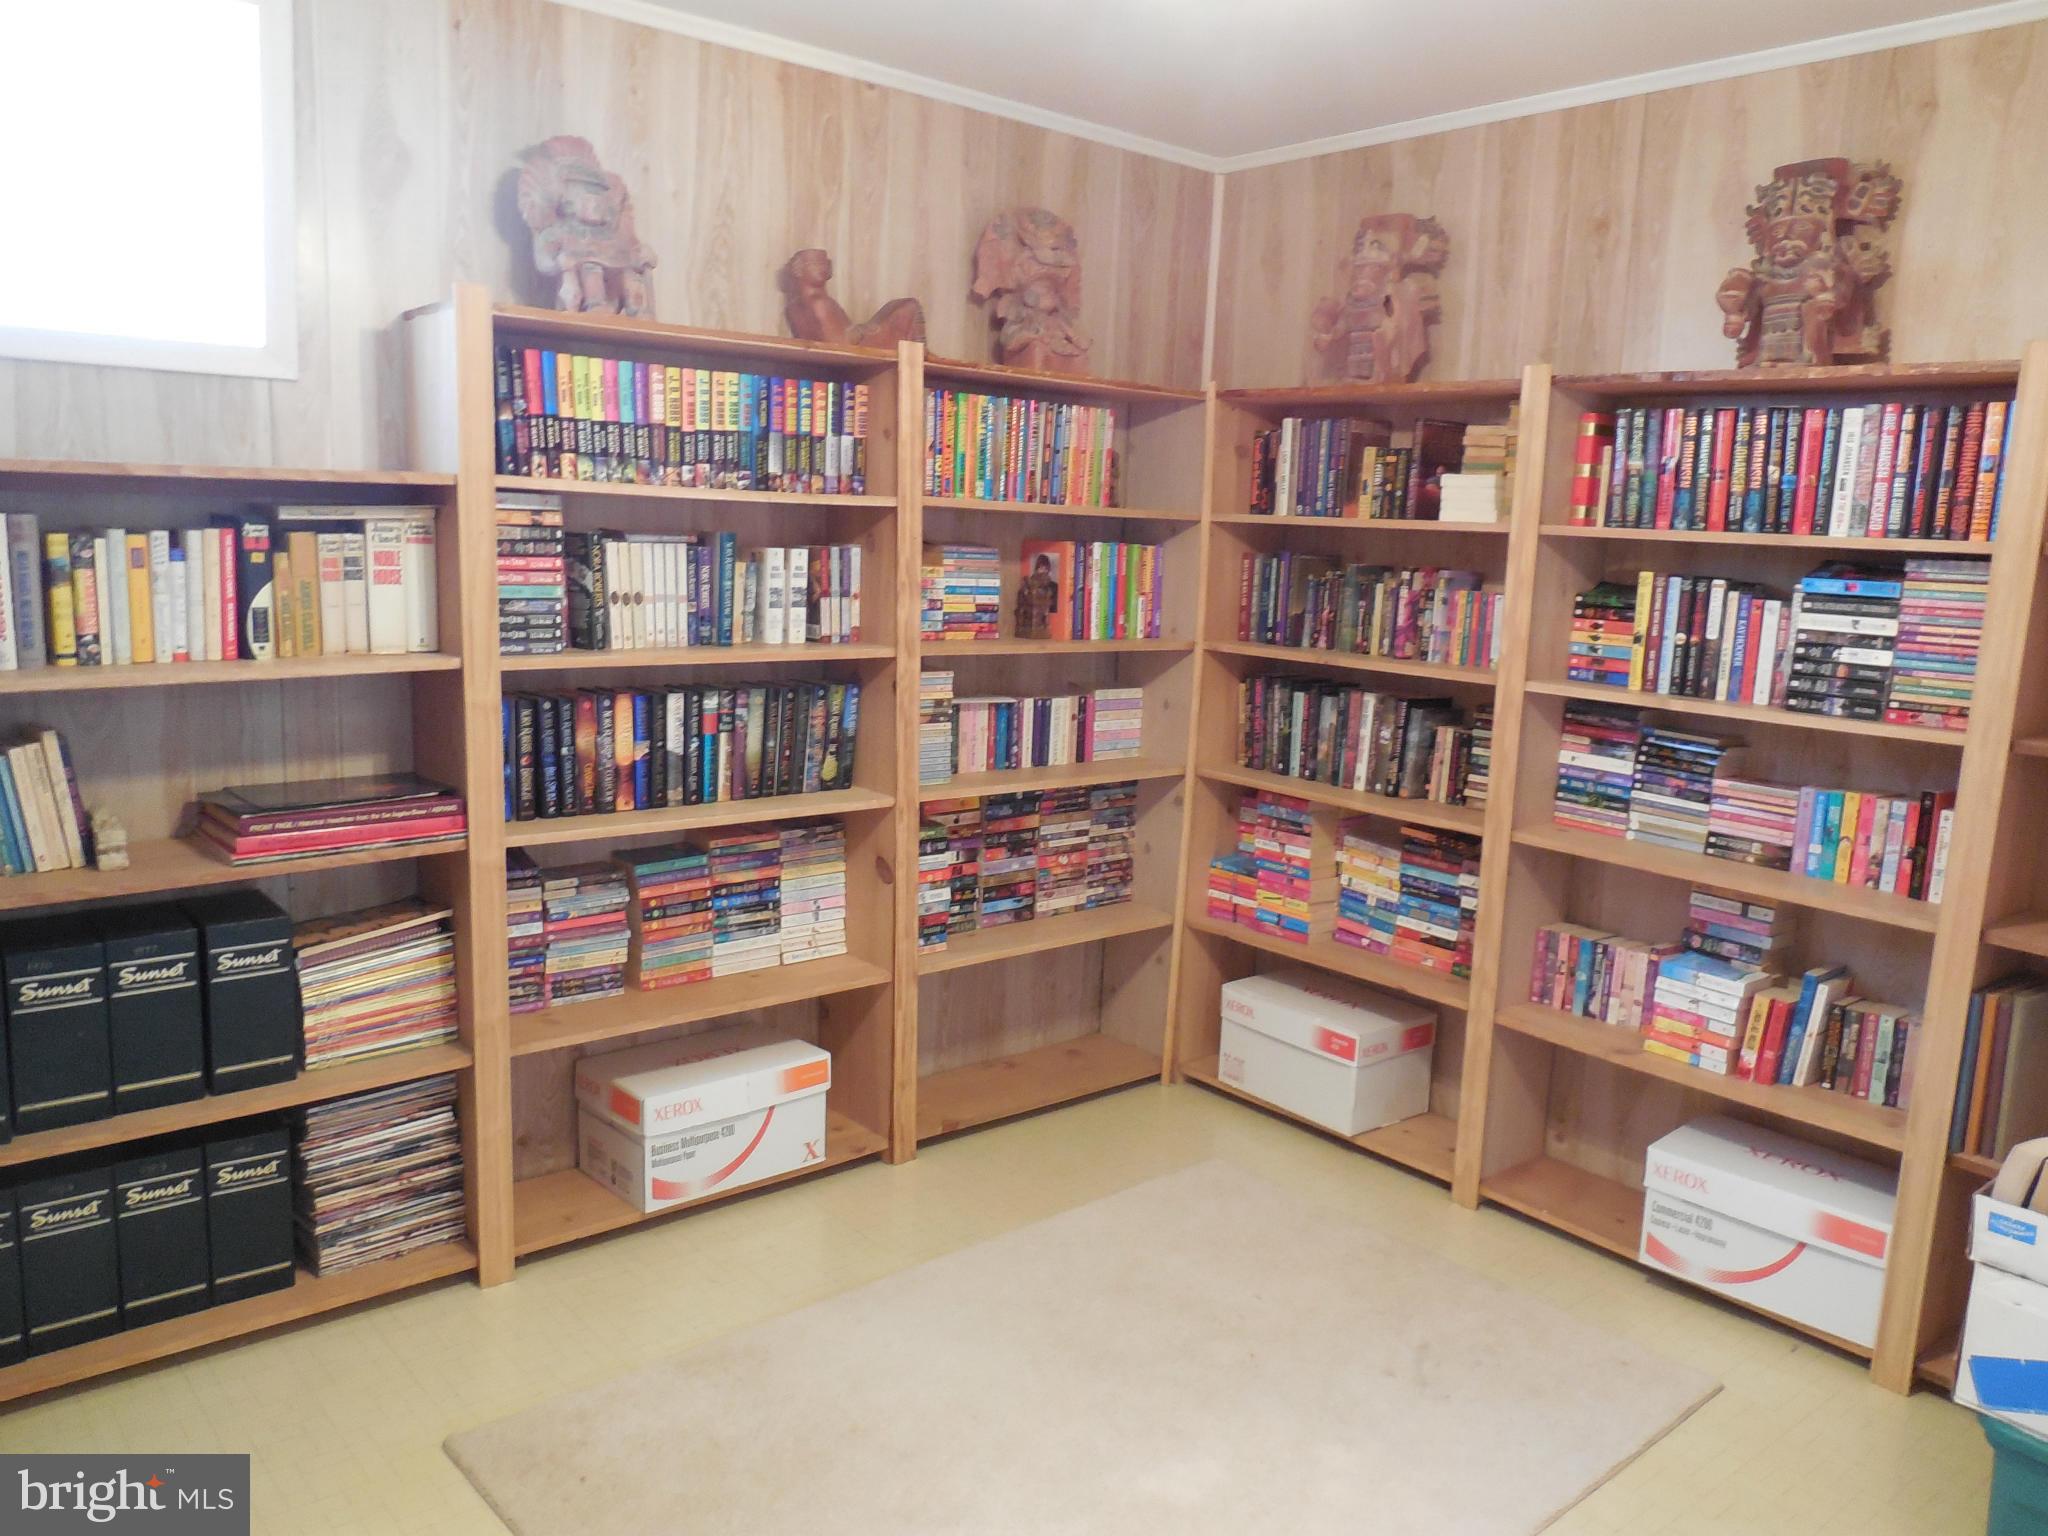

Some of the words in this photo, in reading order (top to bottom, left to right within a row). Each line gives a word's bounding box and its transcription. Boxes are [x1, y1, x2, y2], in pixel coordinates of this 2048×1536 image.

[217, 948, 283, 971] Sunset
[117, 962, 189, 986] Sunset
[19, 978, 95, 1003] Sunset
[653, 1098, 703, 1122] XEROX
[217, 1159, 281, 1186] Sunset
[1652, 1162, 1710, 1195] XEROX
[125, 1178, 194, 1207] Sunset
[31, 1200, 103, 1229] Sunset
